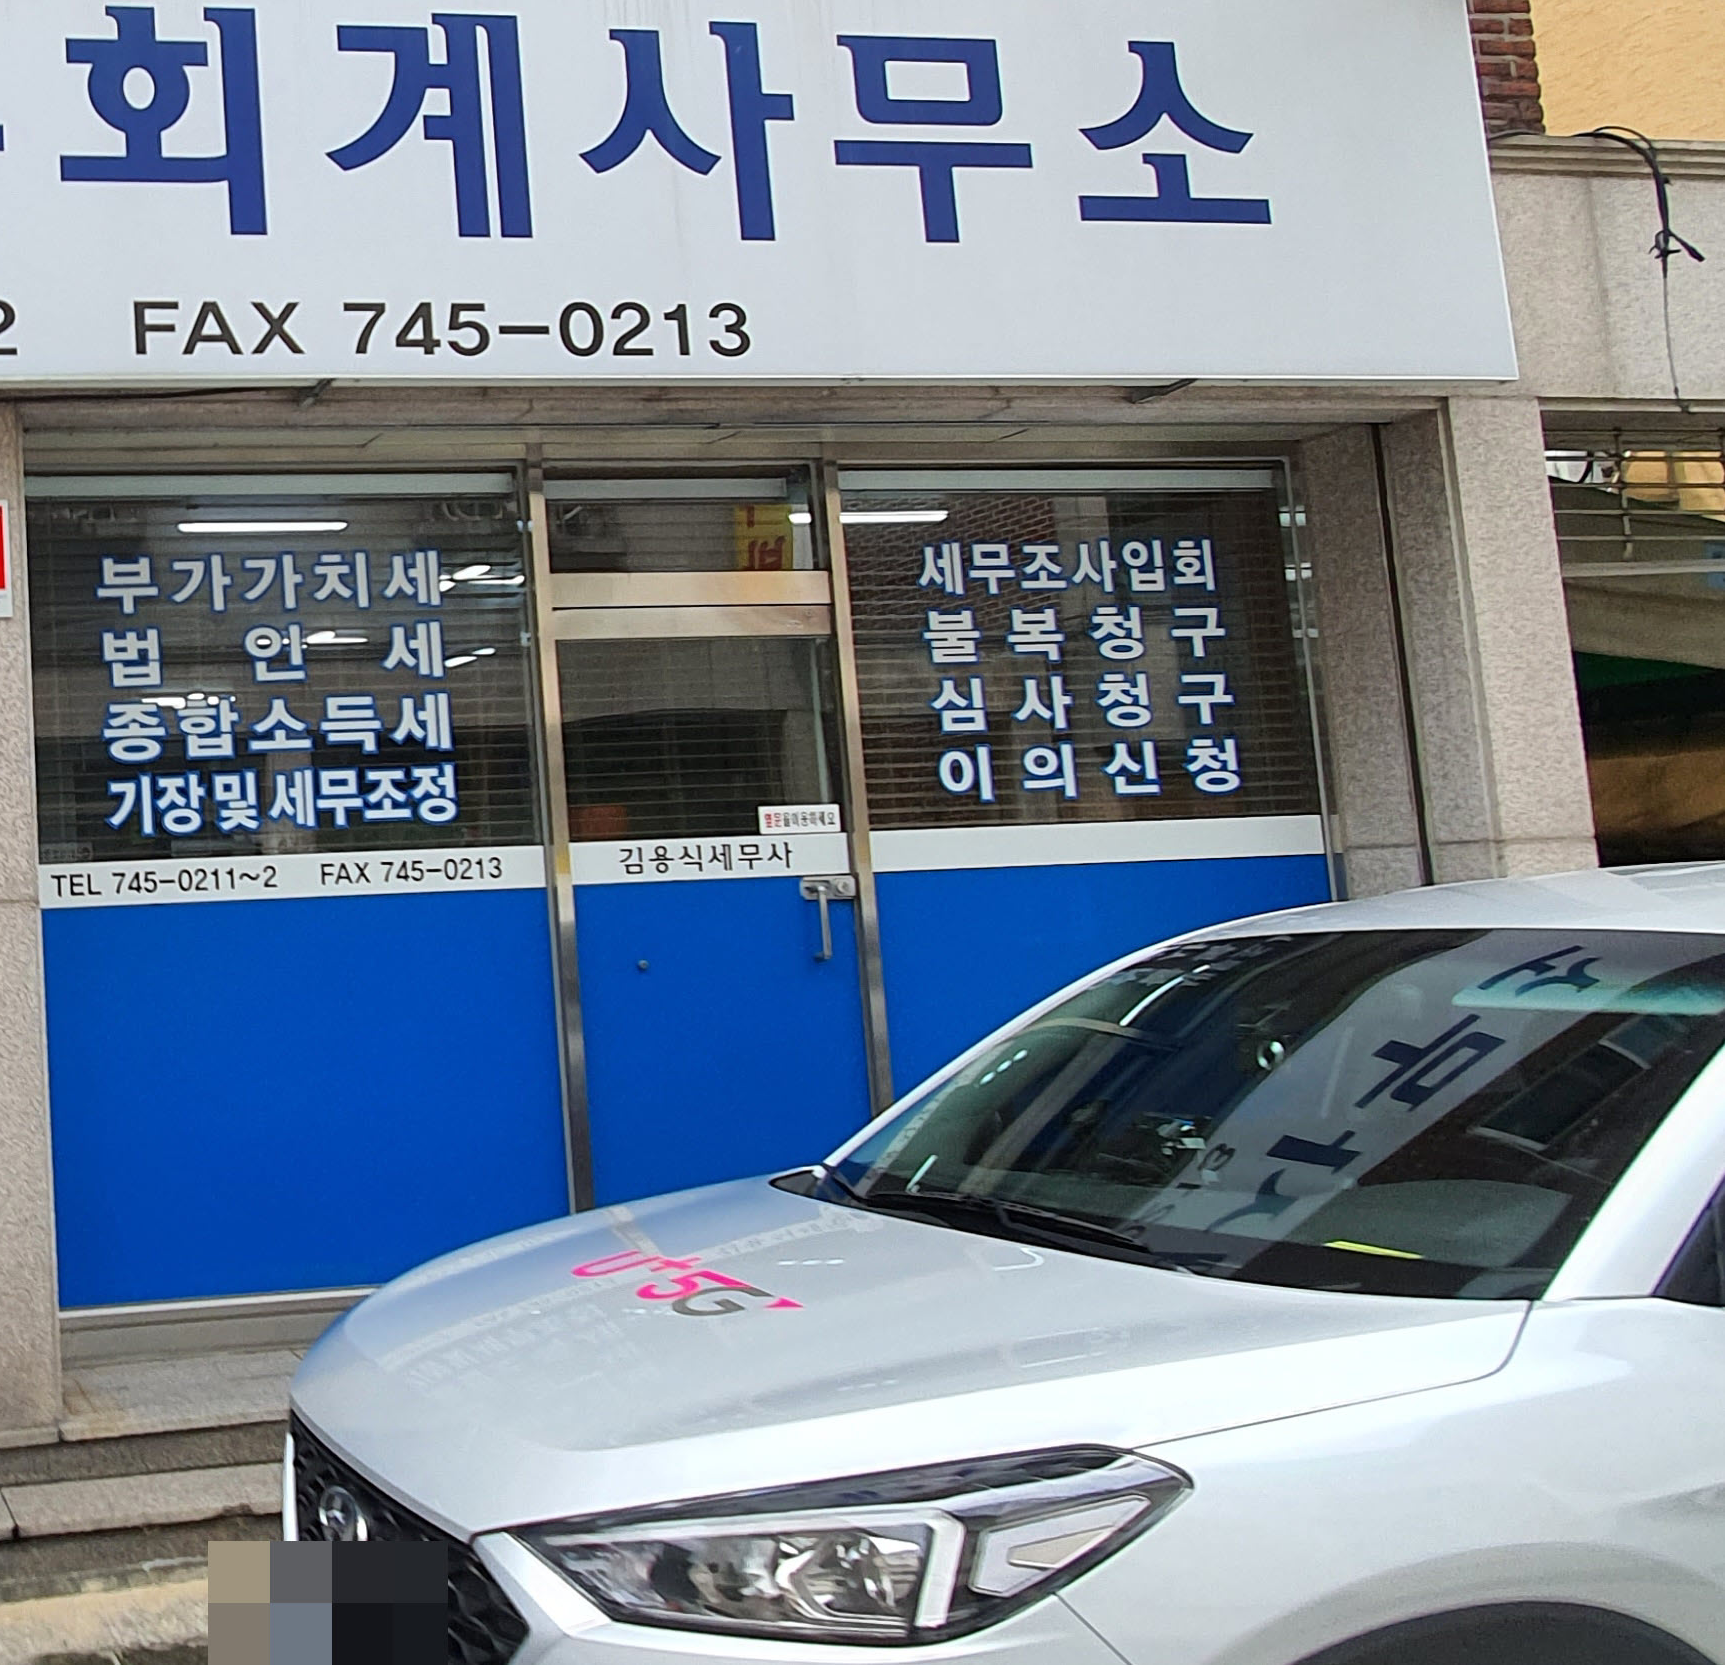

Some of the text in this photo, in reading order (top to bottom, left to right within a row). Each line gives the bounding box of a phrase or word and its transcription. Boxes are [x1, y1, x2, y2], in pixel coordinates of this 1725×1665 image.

[133, 300, 305, 356] FAX
[342, 300, 751, 358] 745-0213
[96, 549, 444, 615] 부가가치세
[918, 537, 1218, 598] 세무조사입회
[103, 692, 455, 765] 종합소득세
[51, 857, 503, 898] TEL 745-0211~2 FAX 745-0213
[619, 841, 793, 875] 김용식세무사
